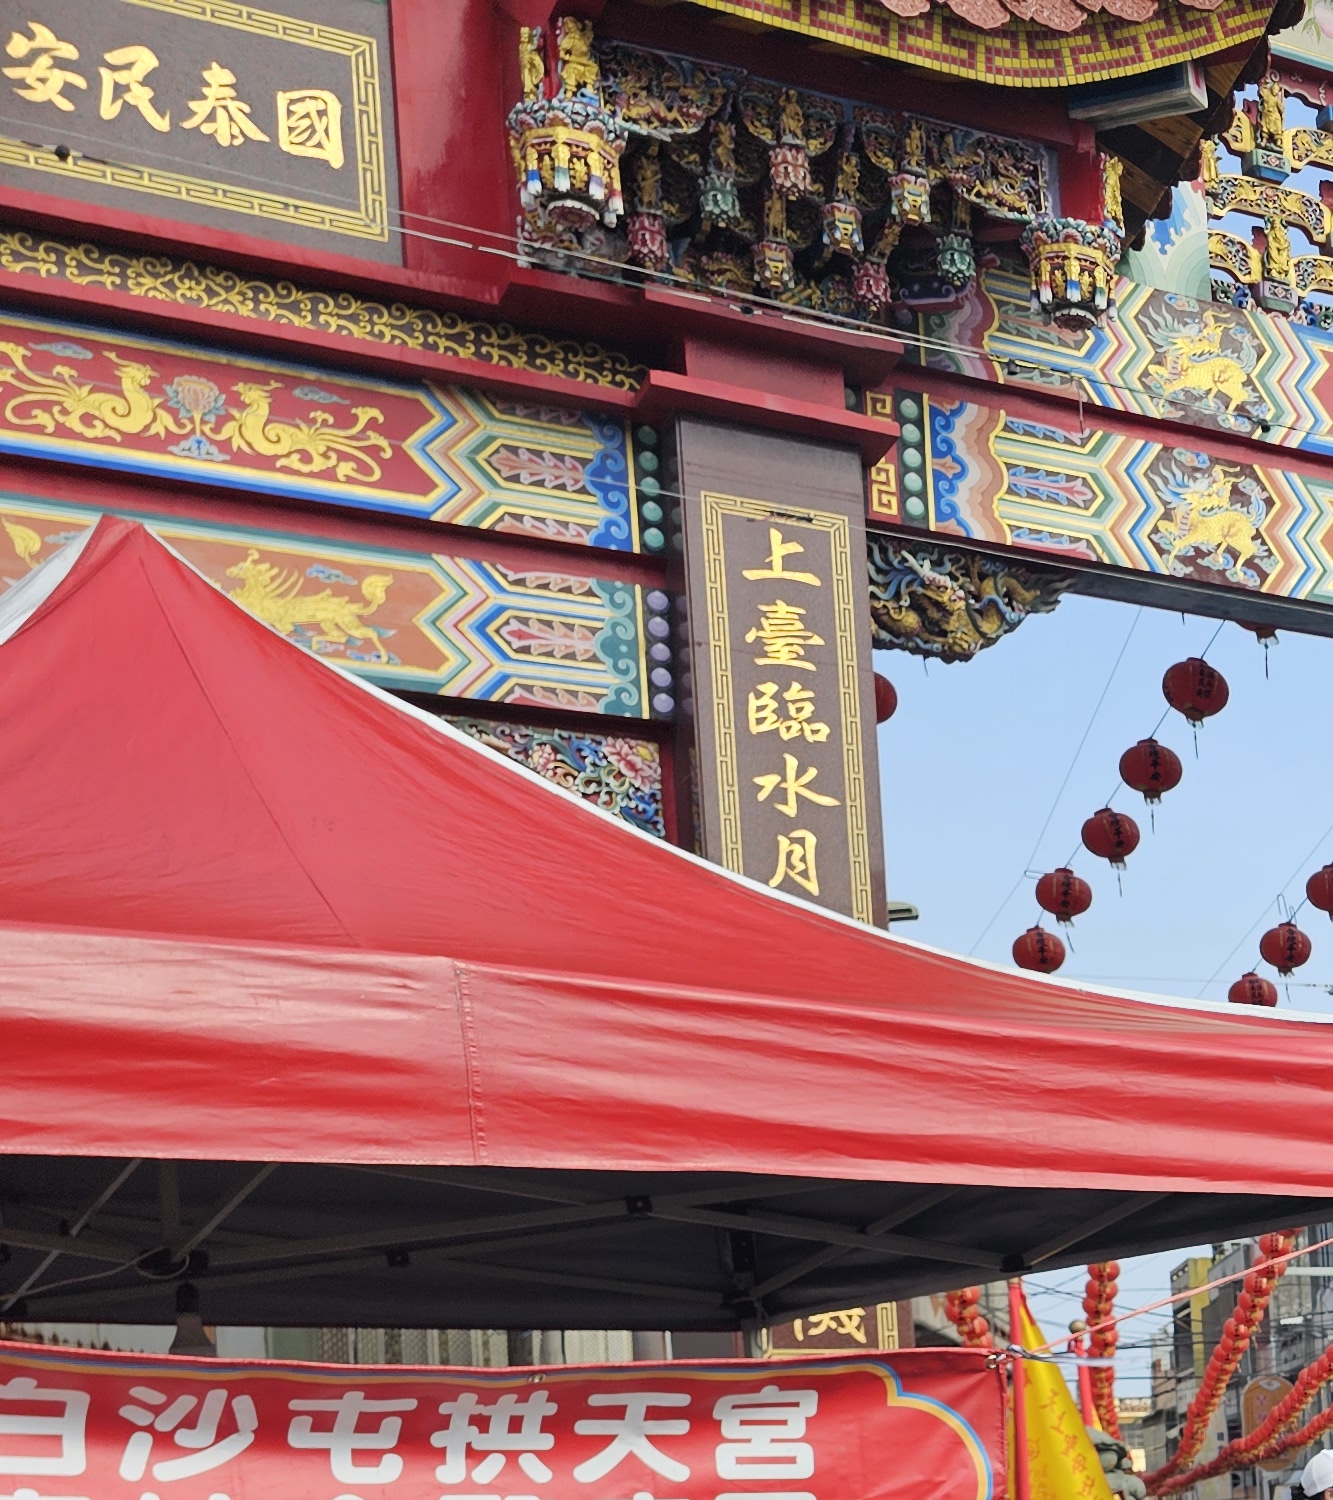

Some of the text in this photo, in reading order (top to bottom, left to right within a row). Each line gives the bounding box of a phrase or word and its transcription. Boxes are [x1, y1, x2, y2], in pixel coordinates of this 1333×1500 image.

[0, 1384, 820, 1485] 白沙屯拱天宮
